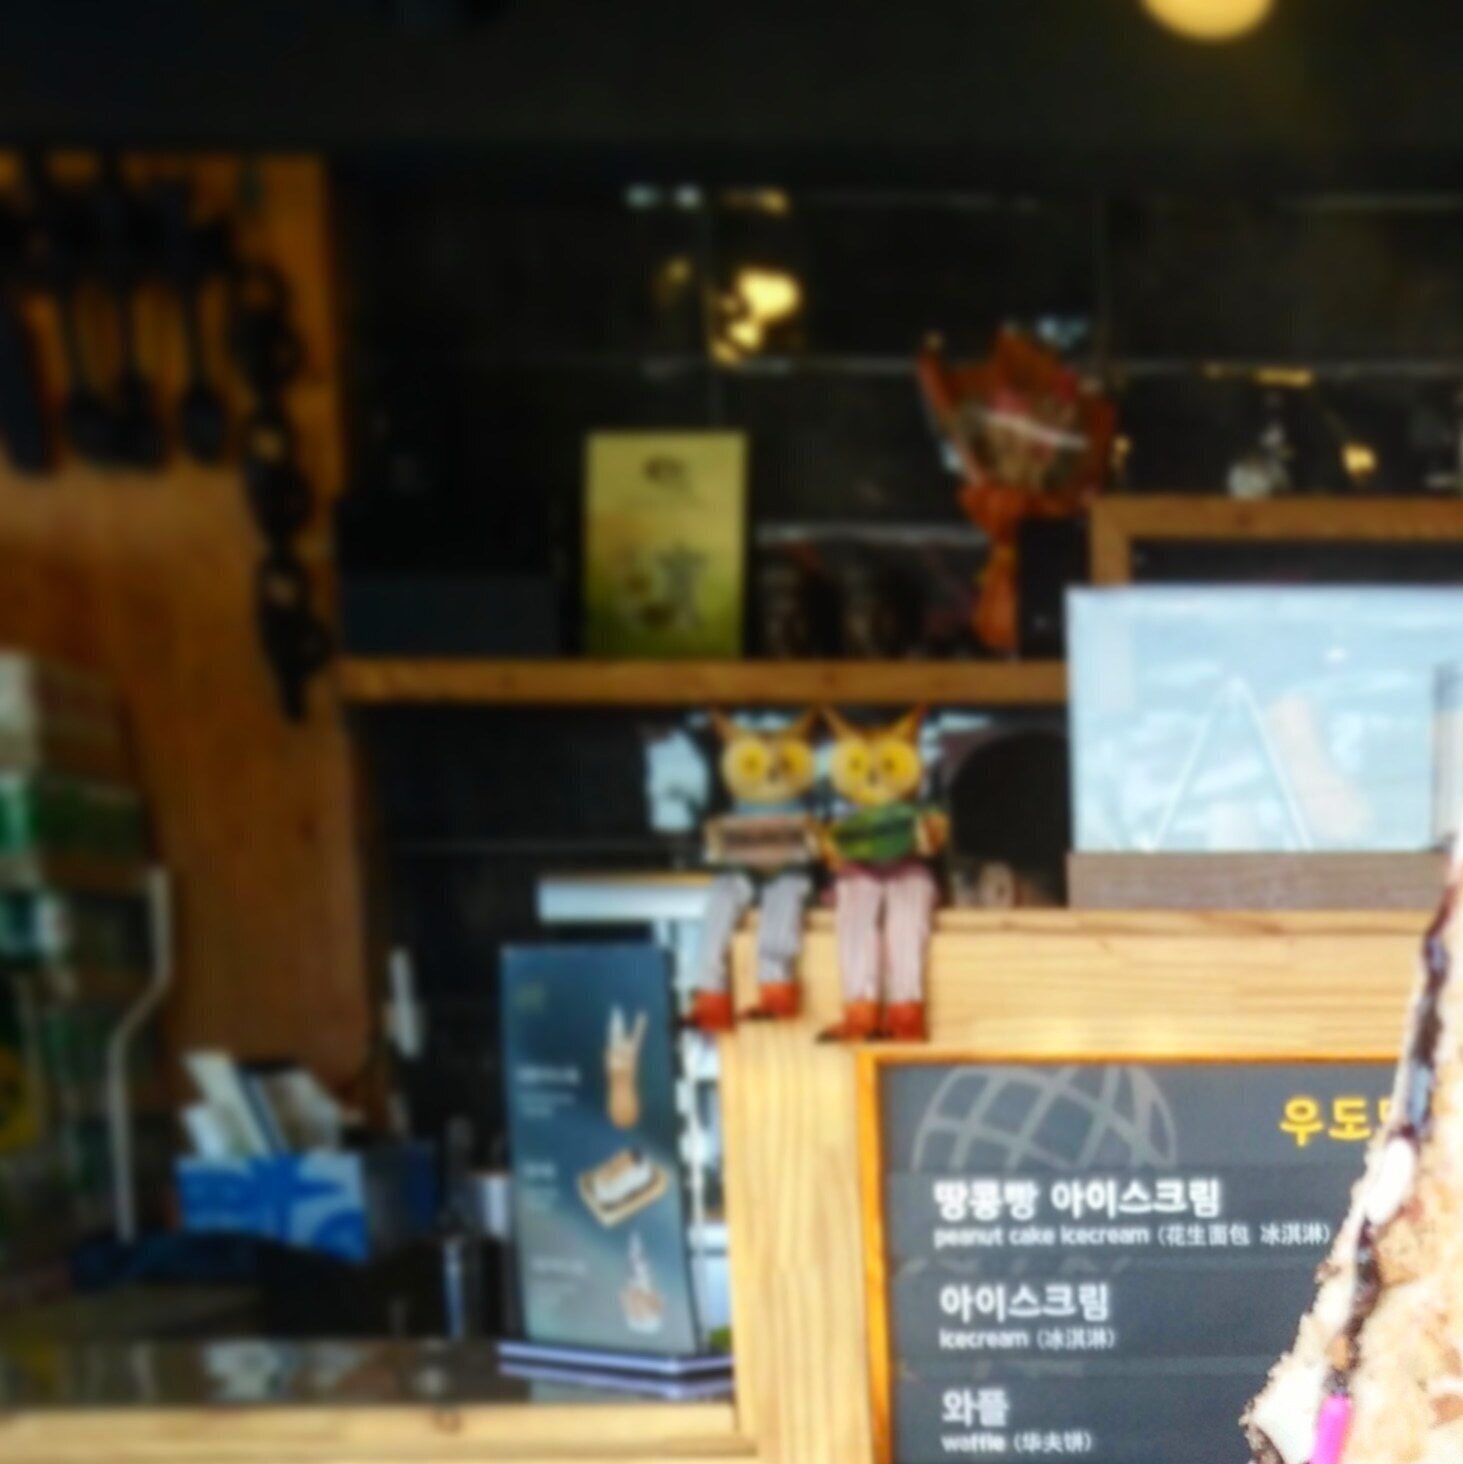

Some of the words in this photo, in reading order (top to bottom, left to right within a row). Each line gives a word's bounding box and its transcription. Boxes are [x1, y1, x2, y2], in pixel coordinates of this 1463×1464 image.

[1050, 1179, 1220, 1219] 아이스크림
[934, 1226, 1002, 1248] peanut
[1009, 1224, 1055, 1245] cake
[1060, 1224, 1149, 1245] icecream
[939, 1283, 1109, 1323] 아이스크림
[939, 1329, 1029, 1349] icecream
